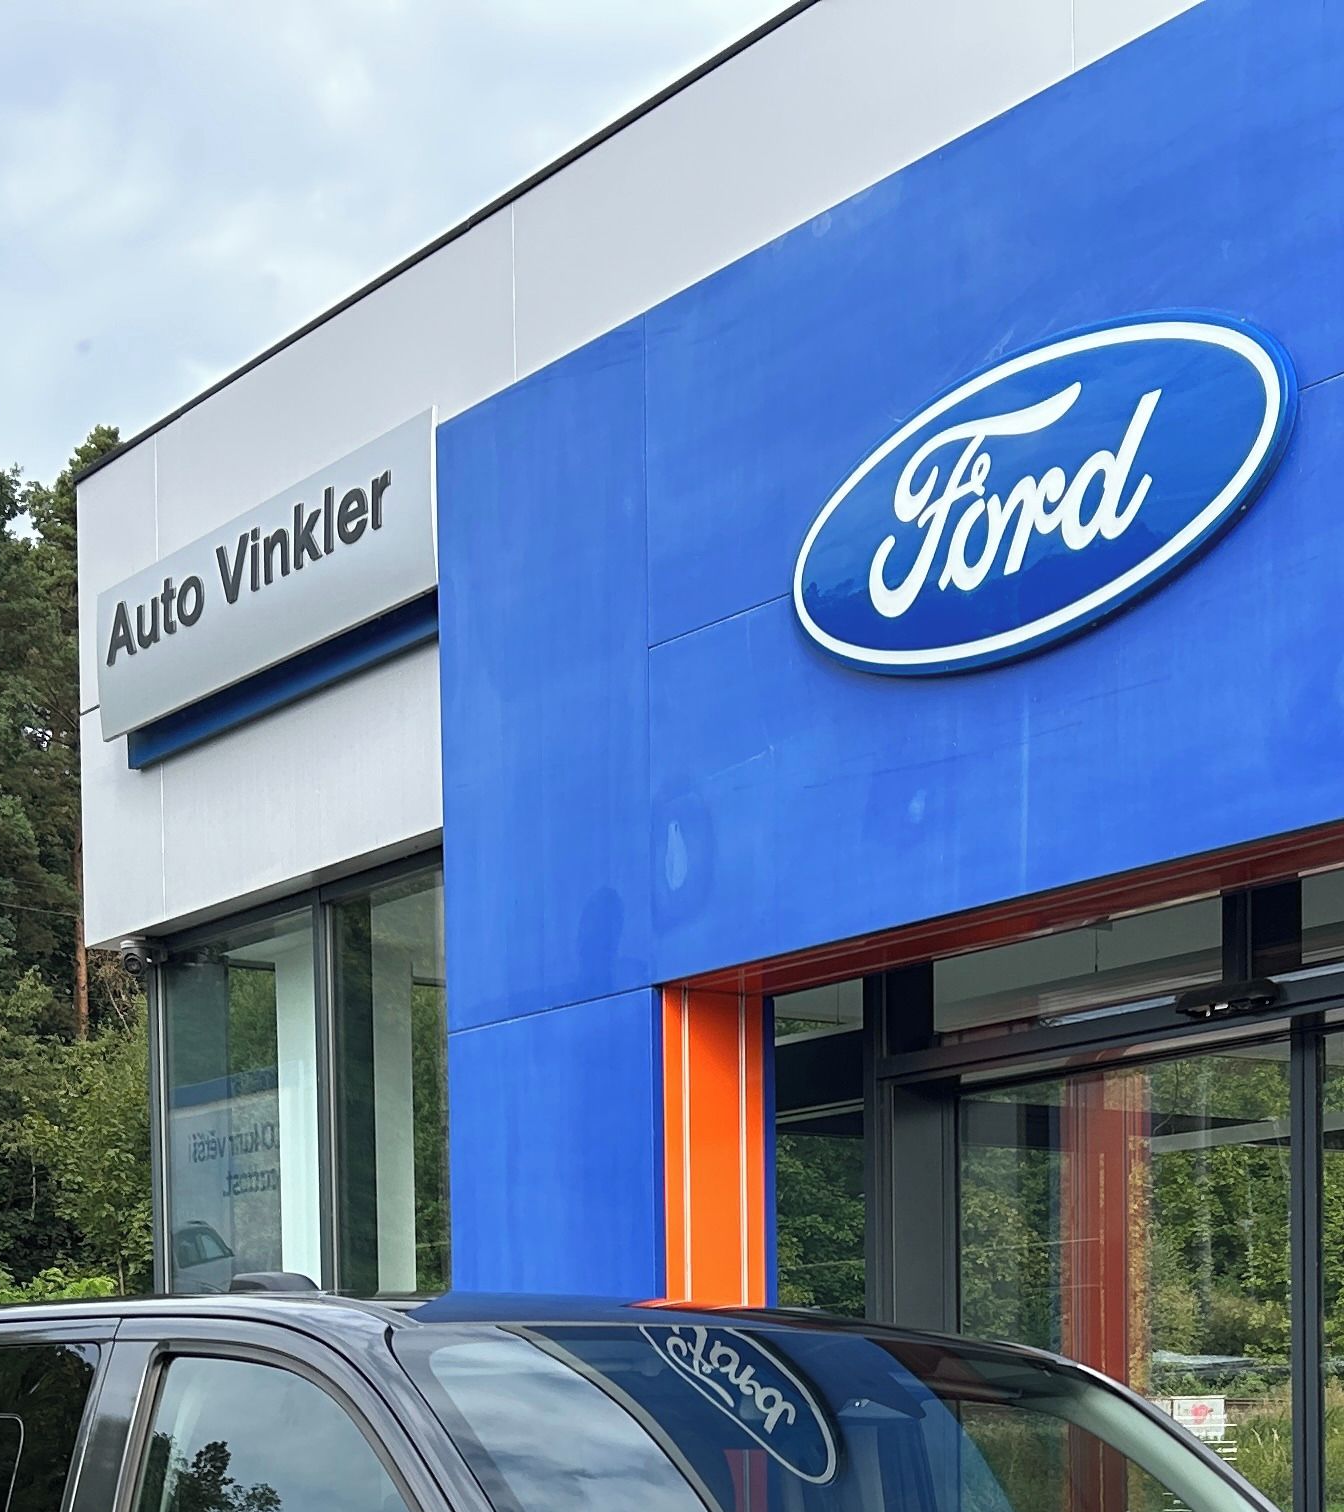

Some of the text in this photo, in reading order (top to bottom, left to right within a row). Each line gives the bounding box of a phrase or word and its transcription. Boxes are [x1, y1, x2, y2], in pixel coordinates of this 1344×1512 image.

[106, 469, 392, 667] Auto Vinkler
[868, 381, 1162, 618] Ford
